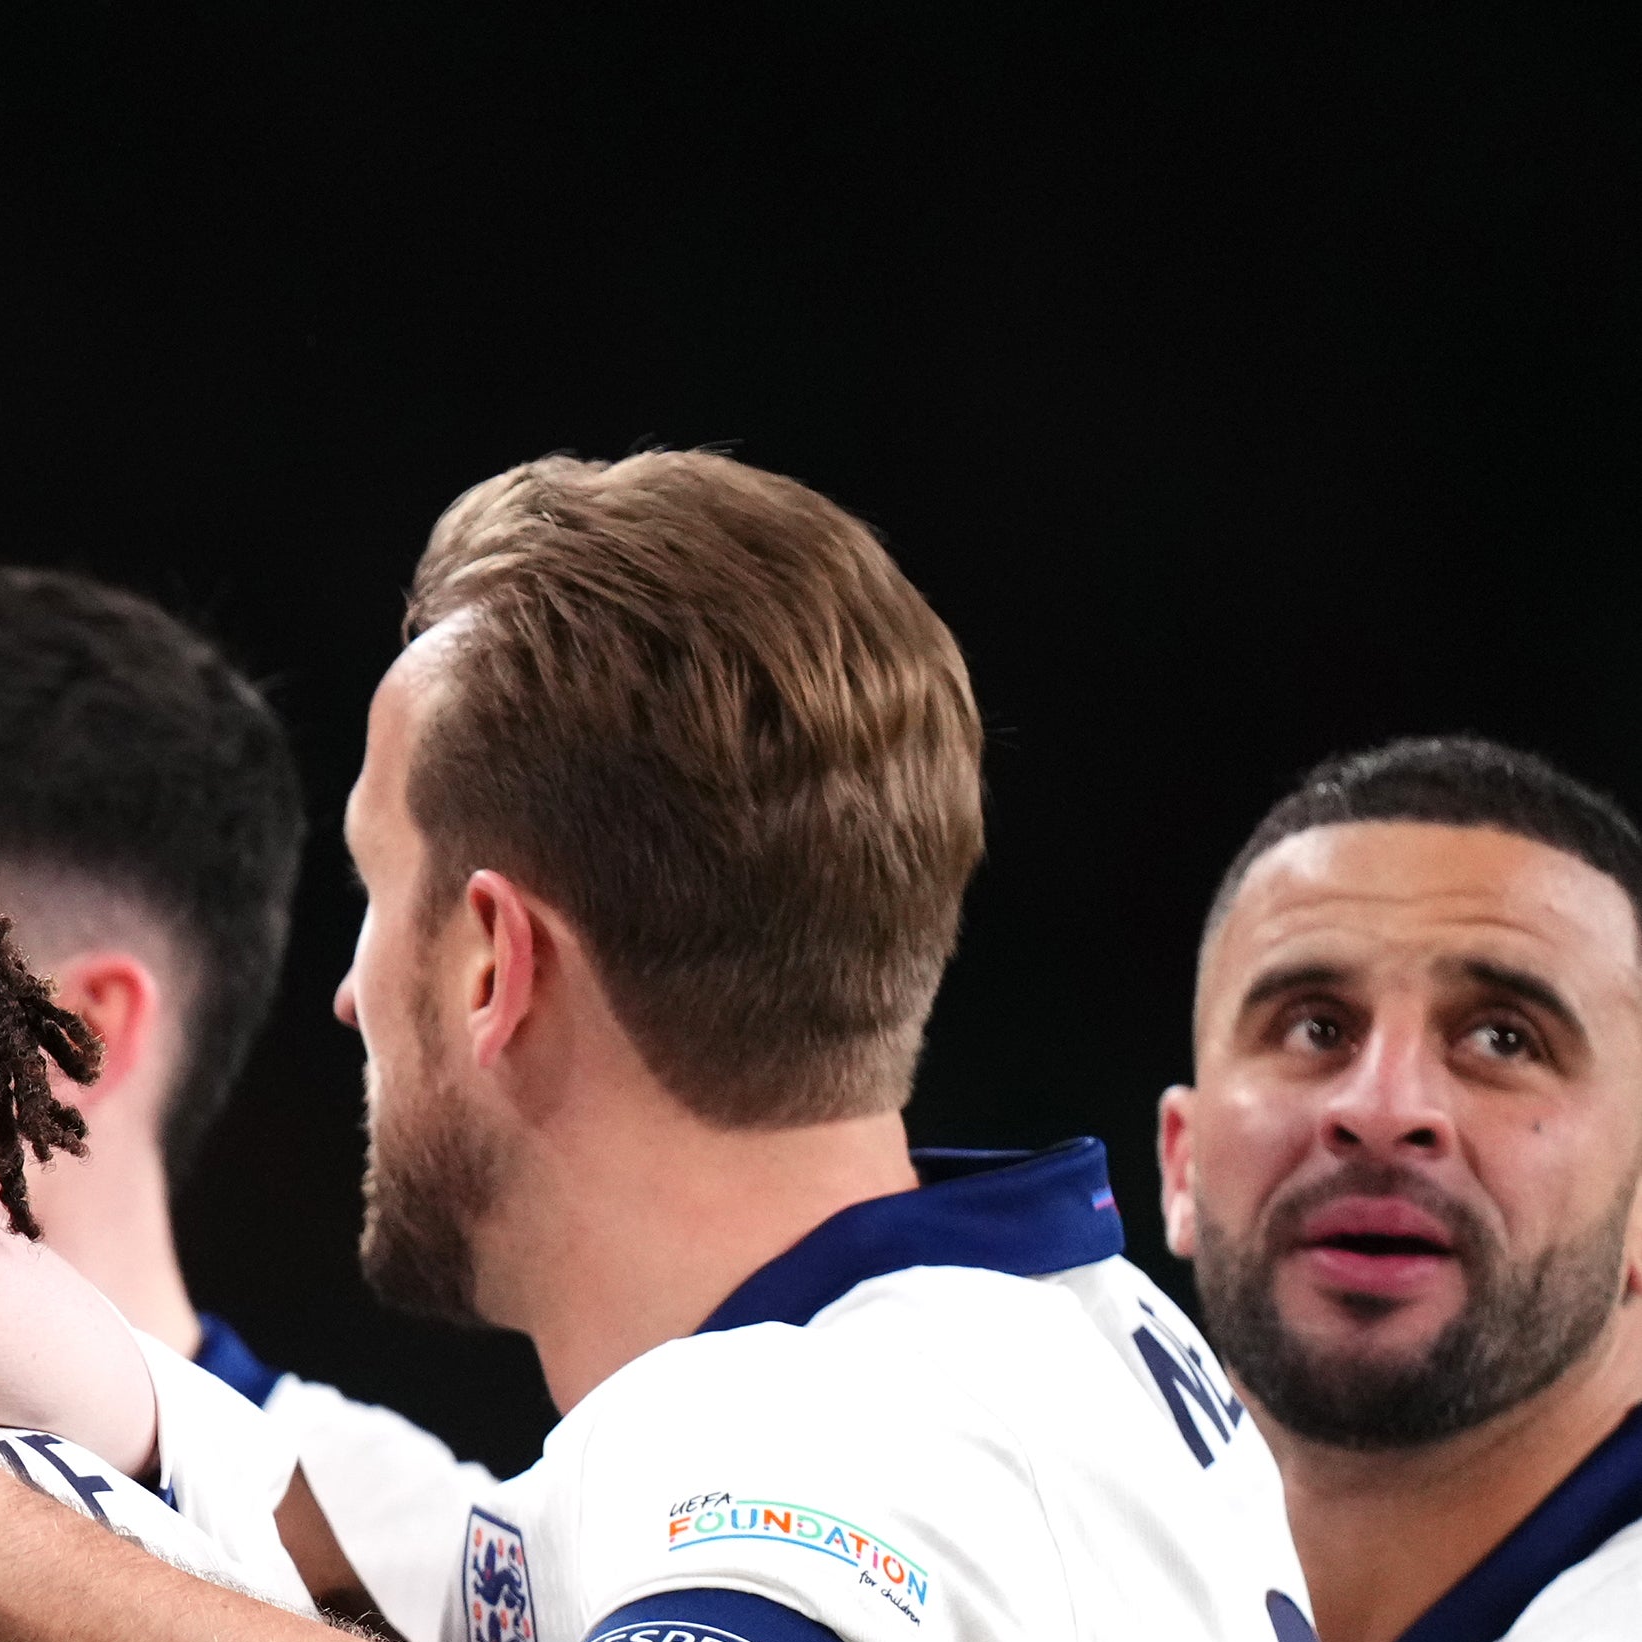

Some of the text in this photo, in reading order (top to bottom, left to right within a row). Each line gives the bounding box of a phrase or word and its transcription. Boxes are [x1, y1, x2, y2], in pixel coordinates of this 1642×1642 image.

[670, 1492, 732, 1517] UEFA
[859, 1570, 921, 1627] for children
